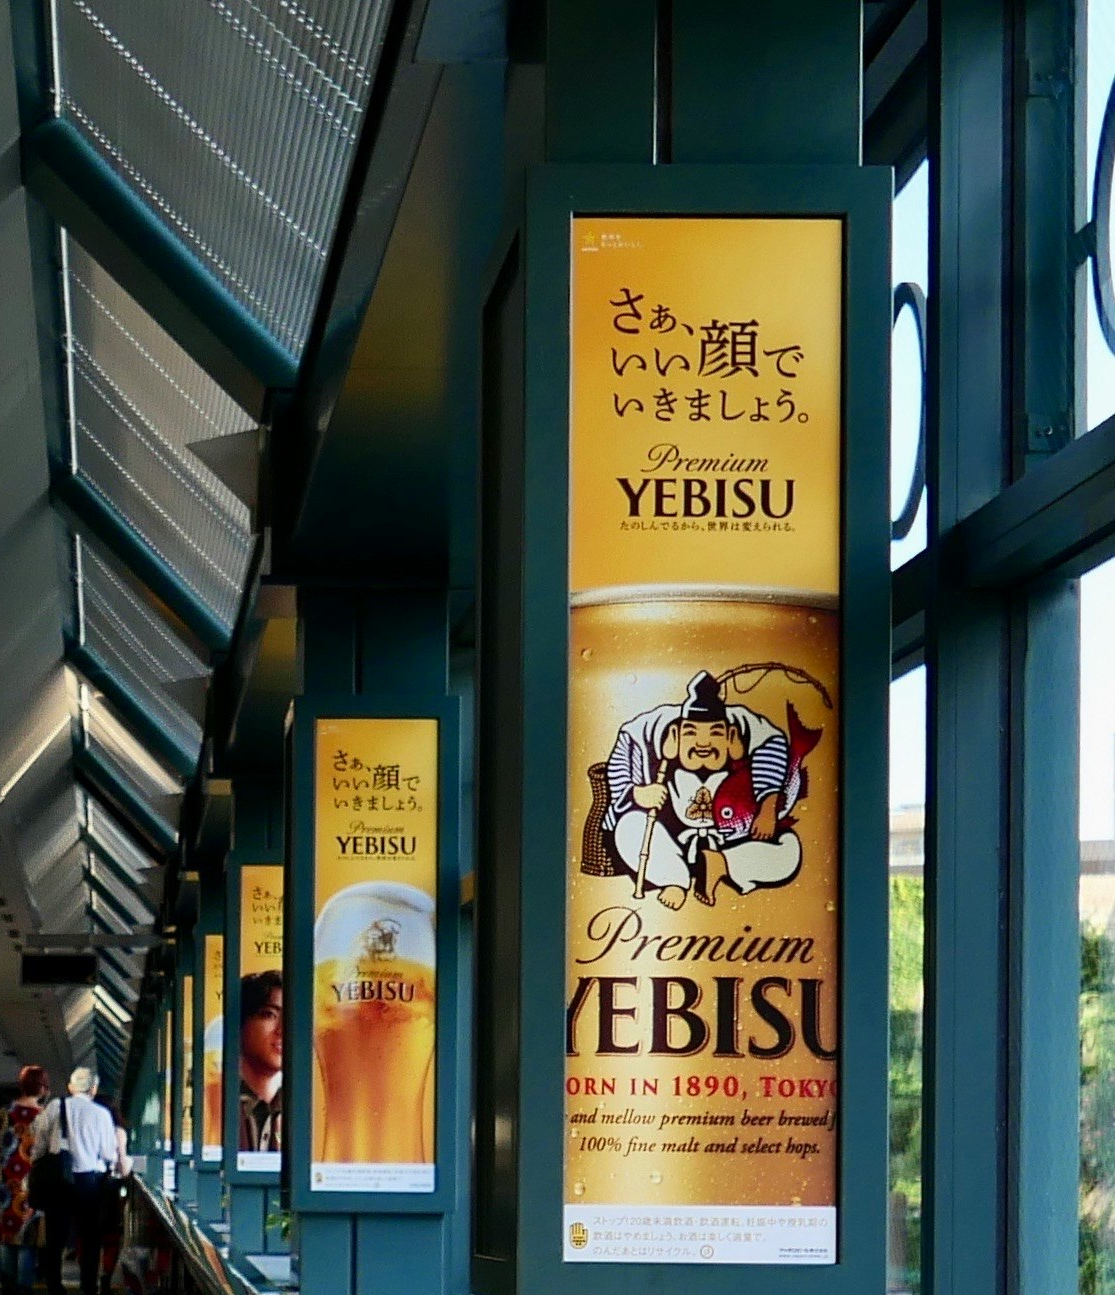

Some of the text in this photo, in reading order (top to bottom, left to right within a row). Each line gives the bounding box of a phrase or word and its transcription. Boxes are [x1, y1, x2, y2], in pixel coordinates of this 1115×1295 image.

[610, 319, 804, 378] いい顔で
[613, 388, 809, 424] いきましょう。
[640, 443, 769, 473] Premium
[616, 478, 796, 519] YEBISU
[332, 764, 421, 791] いい顔で
[333, 795, 423, 812] いきましょう。
[346, 820, 405, 834] Premium
[336, 836, 416, 855] YEBISU
[575, 906, 815, 964] Premium
[332, 981, 415, 1002] YEBISU
[630, 1078, 659, 1096] IN
[672, 1076, 748, 1100] 1890,
[570, 1108, 597, 1125] and
[601, 1109, 655, 1126] mellow
[659, 1111, 735, 1130] premium
[741, 1109, 773, 1127] beer
[777, 1110, 828, 1127] brewed
[579, 1136, 820, 1160] 100% fine malt and select hops.
